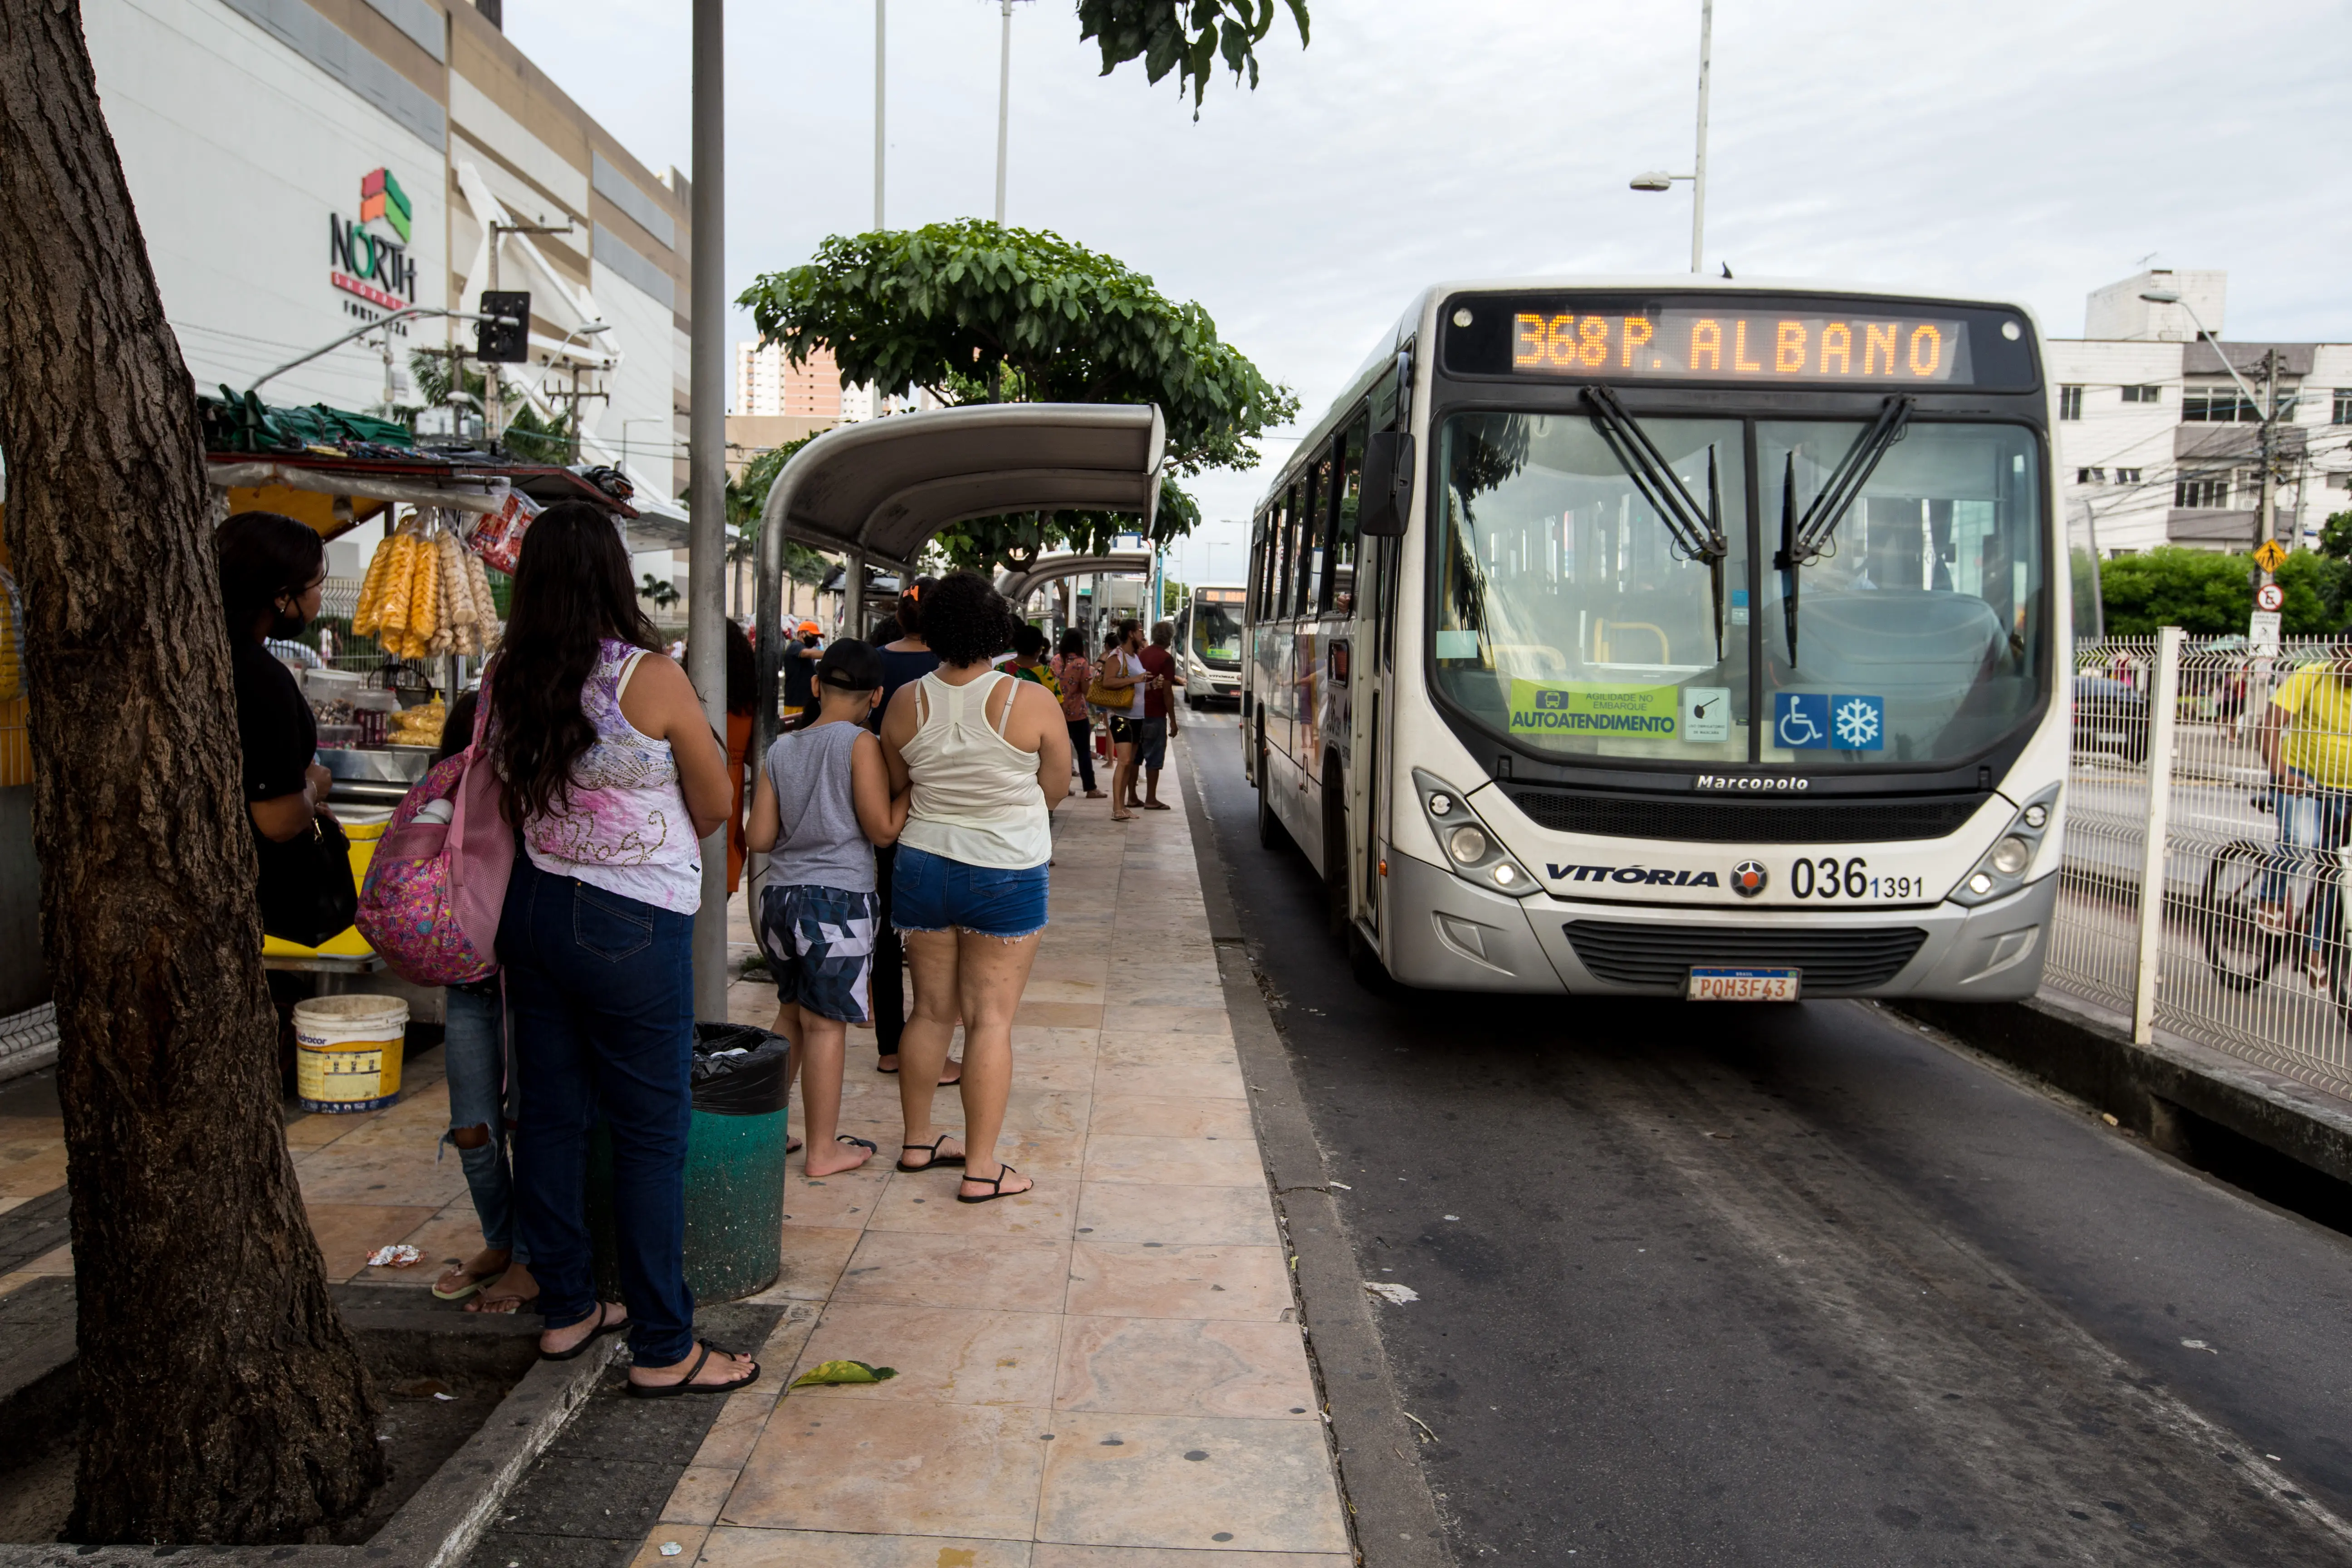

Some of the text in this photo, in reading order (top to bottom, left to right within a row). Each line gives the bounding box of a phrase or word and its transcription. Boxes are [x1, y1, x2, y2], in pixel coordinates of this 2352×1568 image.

[330, 213, 417, 303] NORTH
[333, 273, 414, 314] SHOPPI
[1516, 314, 1942, 376] 368 P. ALBANO
[1586, 693, 1636, 702] AGILIDADE
[1593, 701, 1647, 711] EMBARQUE
[1511, 711, 1675, 733] AUTOATENDIMENTO
[1696, 775, 1808, 791] Marcopolo
[1545, 864, 1720, 888] VITÓRIA
[1791, 858, 1924, 899] 036 1391
